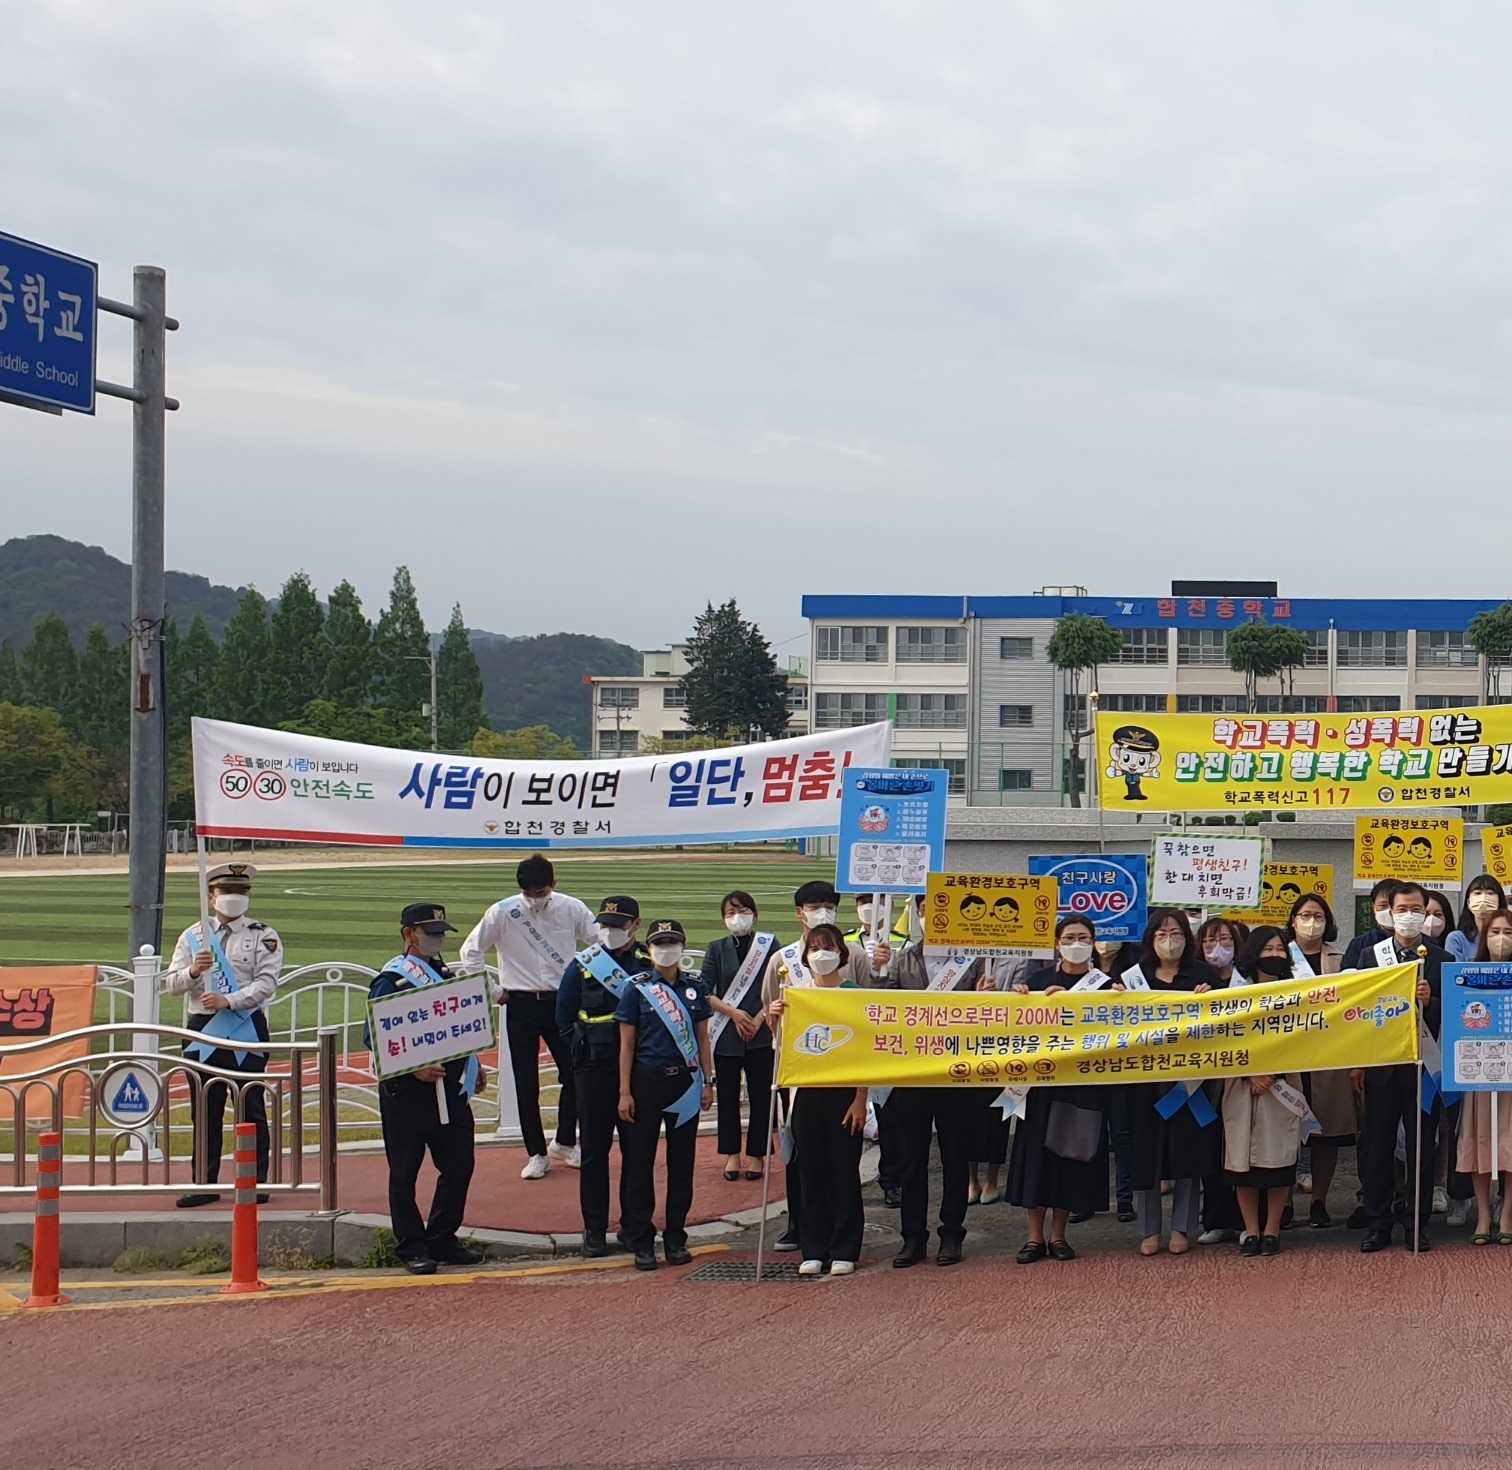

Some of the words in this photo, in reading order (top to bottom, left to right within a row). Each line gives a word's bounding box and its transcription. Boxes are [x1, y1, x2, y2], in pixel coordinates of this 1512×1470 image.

[0, 352, 29, 375] iddle
[36, 361, 79, 387] School
[1157, 599, 1292, 619] 합천중학교
[1212, 717, 1320, 750] 학교폭력
[1344, 716, 1424, 748] 성폭력
[1429, 713, 1481, 743] 없는
[221, 753, 254, 769] 속도를
[255, 758, 283, 771] 줄이면
[285, 757, 319, 773] 사람이
[321, 761, 359, 774] 보입니다
[1175, 750, 1283, 783] 안전하고
[1290, 750, 1370, 781] 행복한
[1378, 749, 1431, 780] 학교
[224, 776, 249, 792] 50
[258, 778, 283, 793] 30
[290, 778, 375, 800] 안전속도
[399, 762, 515, 810] 사람이
[521, 769, 621, 809] 보이면
[762, 750, 852, 804] 멈춤!
[1224, 789, 1309, 806] 학교폭력신고
[1312, 787, 1351, 806] 117
[1401, 786, 1471, 801] 합천경찰서
[504, 820, 612, 836] 합천경찰서
[1370, 818, 1449, 831] 교육환경보호구역
[1177, 841, 1216, 857] 참으면
[1192, 857, 1248, 872] 평생친구!
[944, 875, 1041, 890] 교육환경보호구역
[1061, 871, 1117, 885] 친구사랑
[1165, 870, 1179, 884] 한
[1181, 871, 1194, 884] 대
[1198, 872, 1223, 886] 치면
[1056, 891, 1127, 912] Love
[1197, 884, 1252, 900] 후회막급!
[963, 948, 1034, 957] 경상남도합천교육지원청
[407, 1008, 430, 1024] 있는
[433, 994, 484, 1017] 친구에게
[904, 1005, 1010, 1029] 경계선으로부터
[1015, 1006, 1075, 1027] 200M는
[1209, 997, 1252, 1016] 학생의
[1259, 991, 1302, 1010] 학습과
[1307, 985, 1341, 1006] 안전,
[388, 1036, 407, 1057] 손!
[412, 1030, 448, 1048] 내밀어
[450, 1017, 487, 1038] 주세요!
[873, 1034, 908, 1057] 보건,
[914, 1035, 961, 1057] 위생에
[1045, 1034, 1075, 1052] 주는
[1081, 1032, 1110, 1051] 행위
[1116, 1032, 1129, 1048] 및
[1135, 1027, 1181, 1047] 시설을
[1186, 1021, 1246, 1040] 제한하는
[1251, 1012, 1330, 1036] 지역입니다.
[1077, 1048, 1250, 1074] 경상남도합천교육지원청
